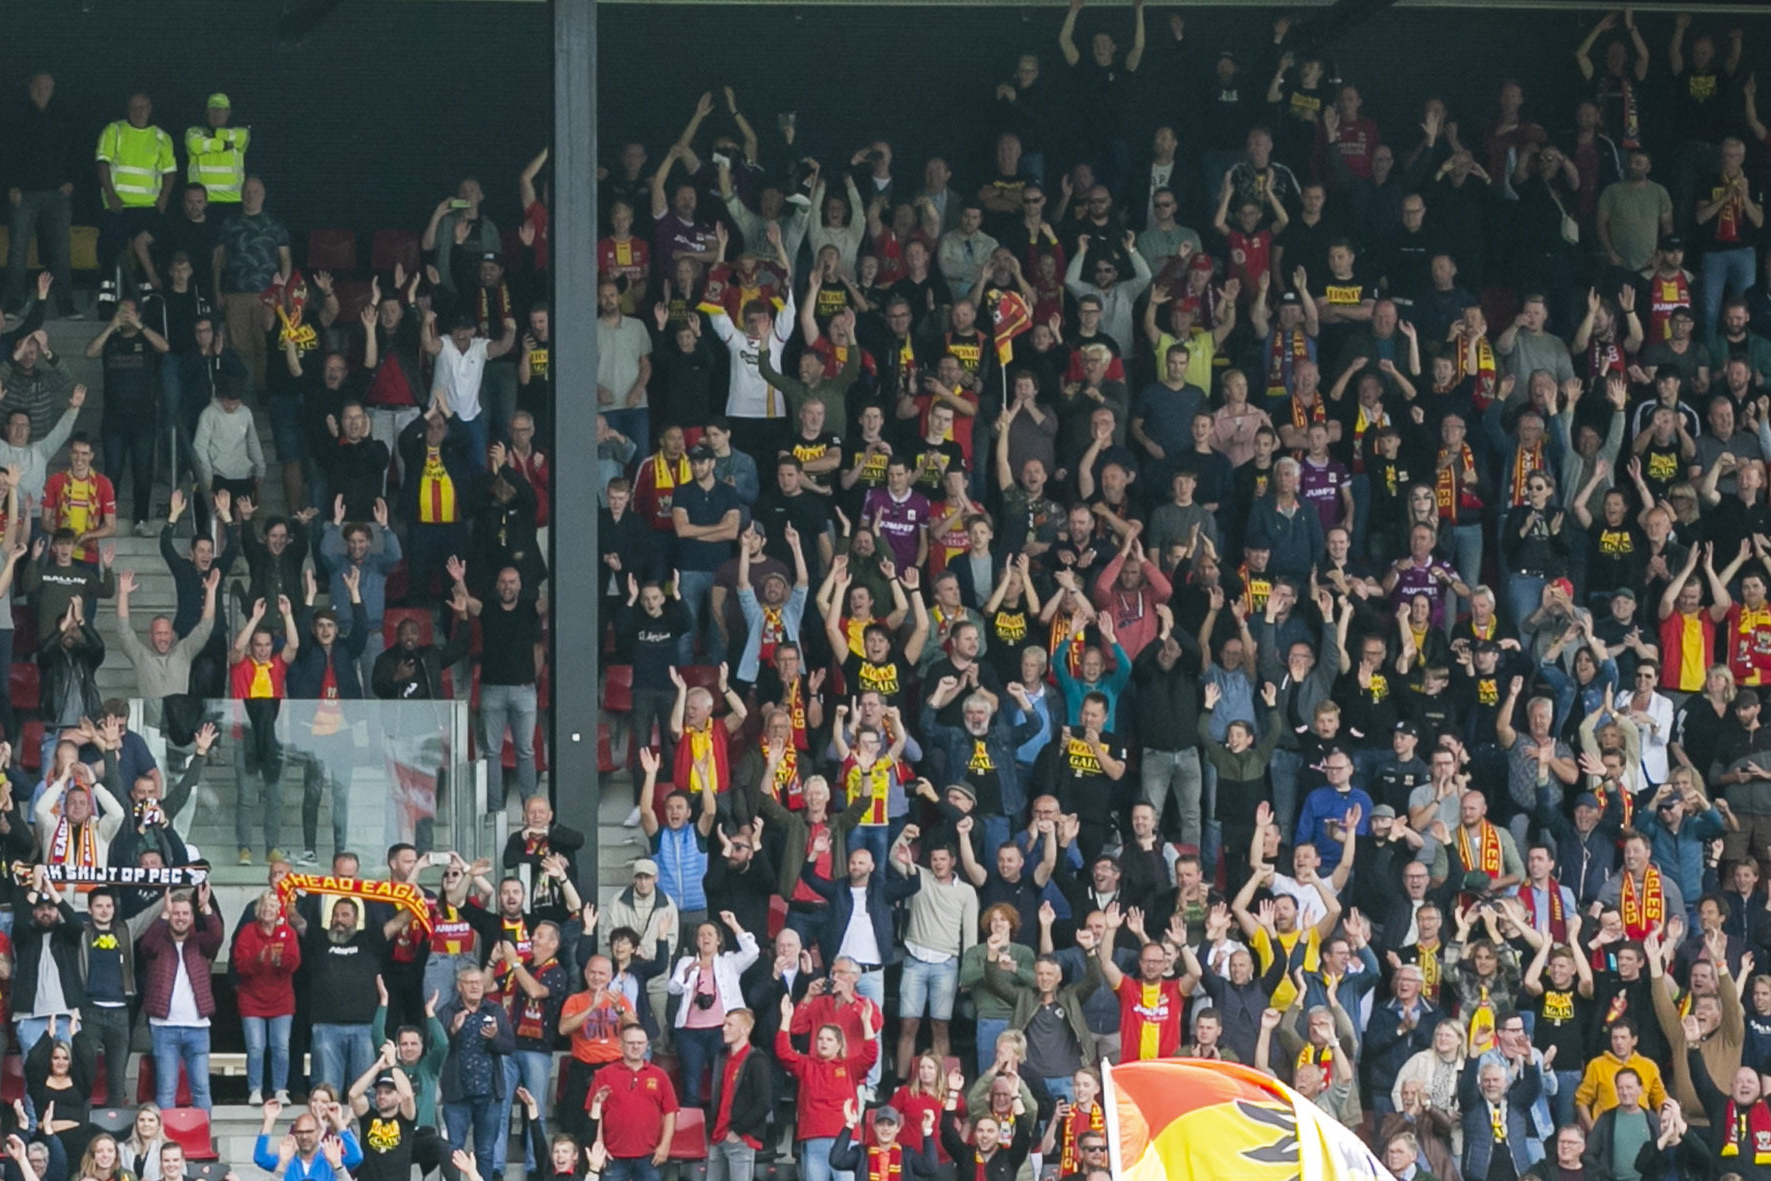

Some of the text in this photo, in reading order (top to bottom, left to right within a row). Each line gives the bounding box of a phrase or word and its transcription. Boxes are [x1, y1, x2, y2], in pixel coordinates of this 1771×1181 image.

[65, 864, 118, 882] SHIJT
[121, 866, 147, 882] OP
[148, 867, 182, 884] PEC
[281, 872, 430, 920] AHEAD EAGLES
